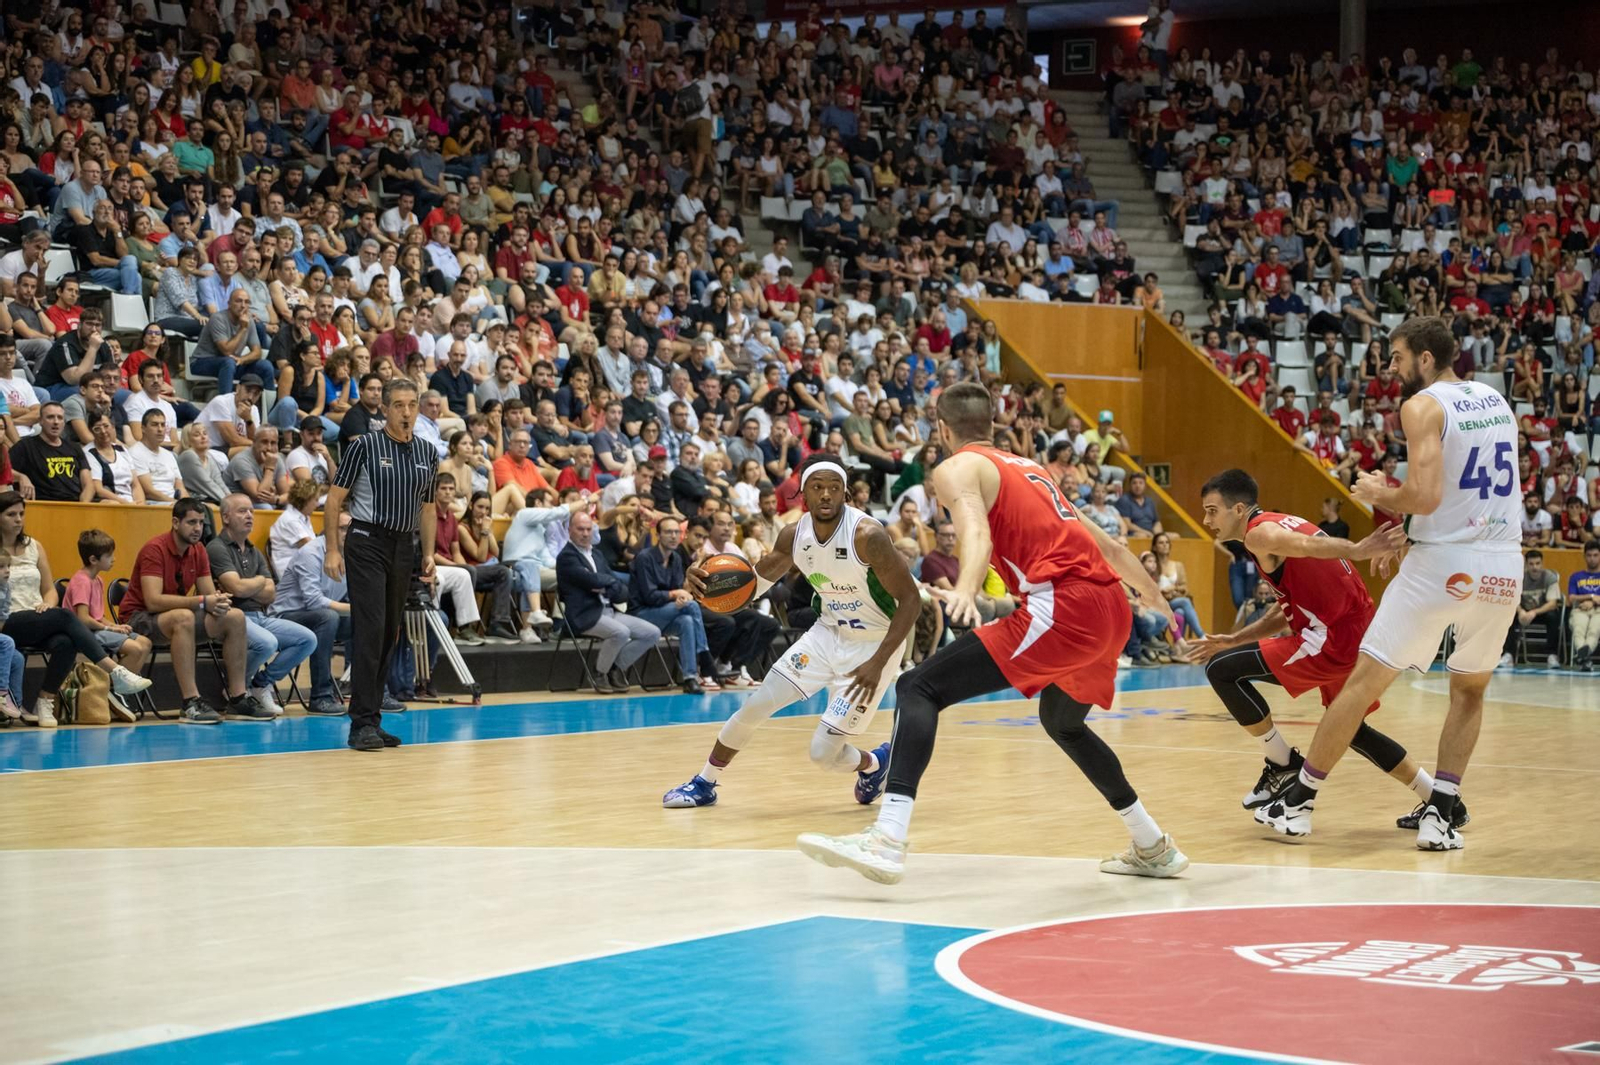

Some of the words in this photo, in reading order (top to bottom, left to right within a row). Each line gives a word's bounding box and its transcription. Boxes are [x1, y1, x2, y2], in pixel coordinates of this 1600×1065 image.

[1453, 394, 1503, 413] KRAVISH
[1459, 442, 1514, 500] 45
[1481, 575, 1517, 589] COSTA
[1478, 586, 1497, 595] DEL
[1499, 588, 1515, 598] SOL
